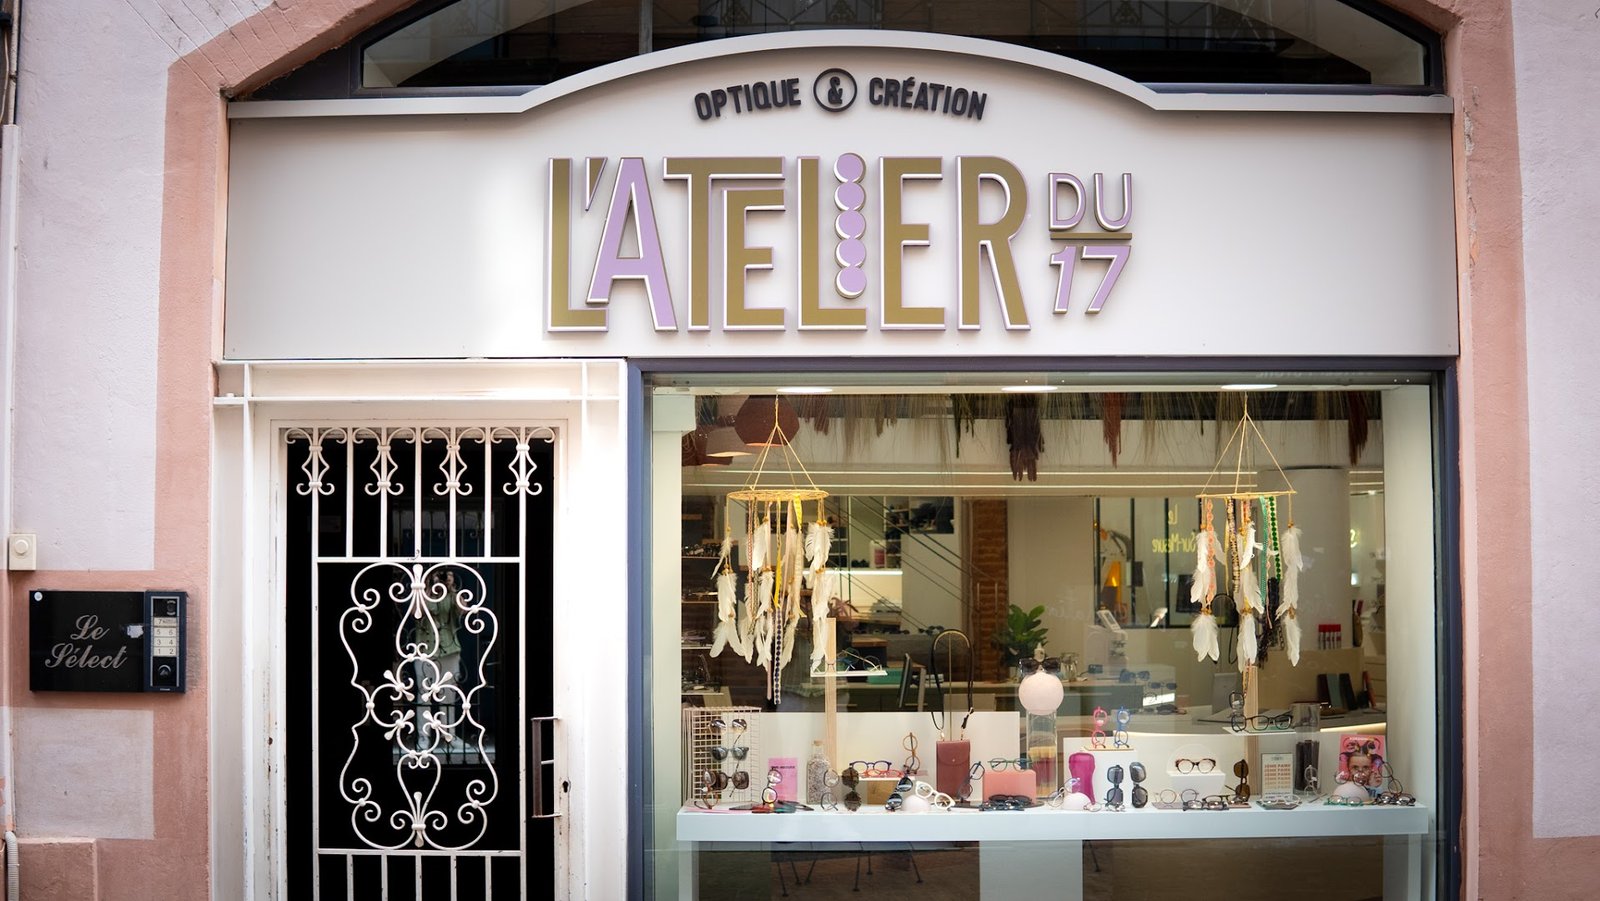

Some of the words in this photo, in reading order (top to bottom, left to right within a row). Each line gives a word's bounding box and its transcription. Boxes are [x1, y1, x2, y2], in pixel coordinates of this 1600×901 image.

[694, 78, 800, 120] OPTIQUE
[826, 77, 843, 105] &
[868, 76, 988, 121] CRÉATION
[1048, 172, 1133, 232] DU
[547, 153, 1031, 332] L'ATELIER
[1049, 245, 1131, 314] 17
[70, 614, 110, 640] Le
[44, 642, 128, 669] Sélect
